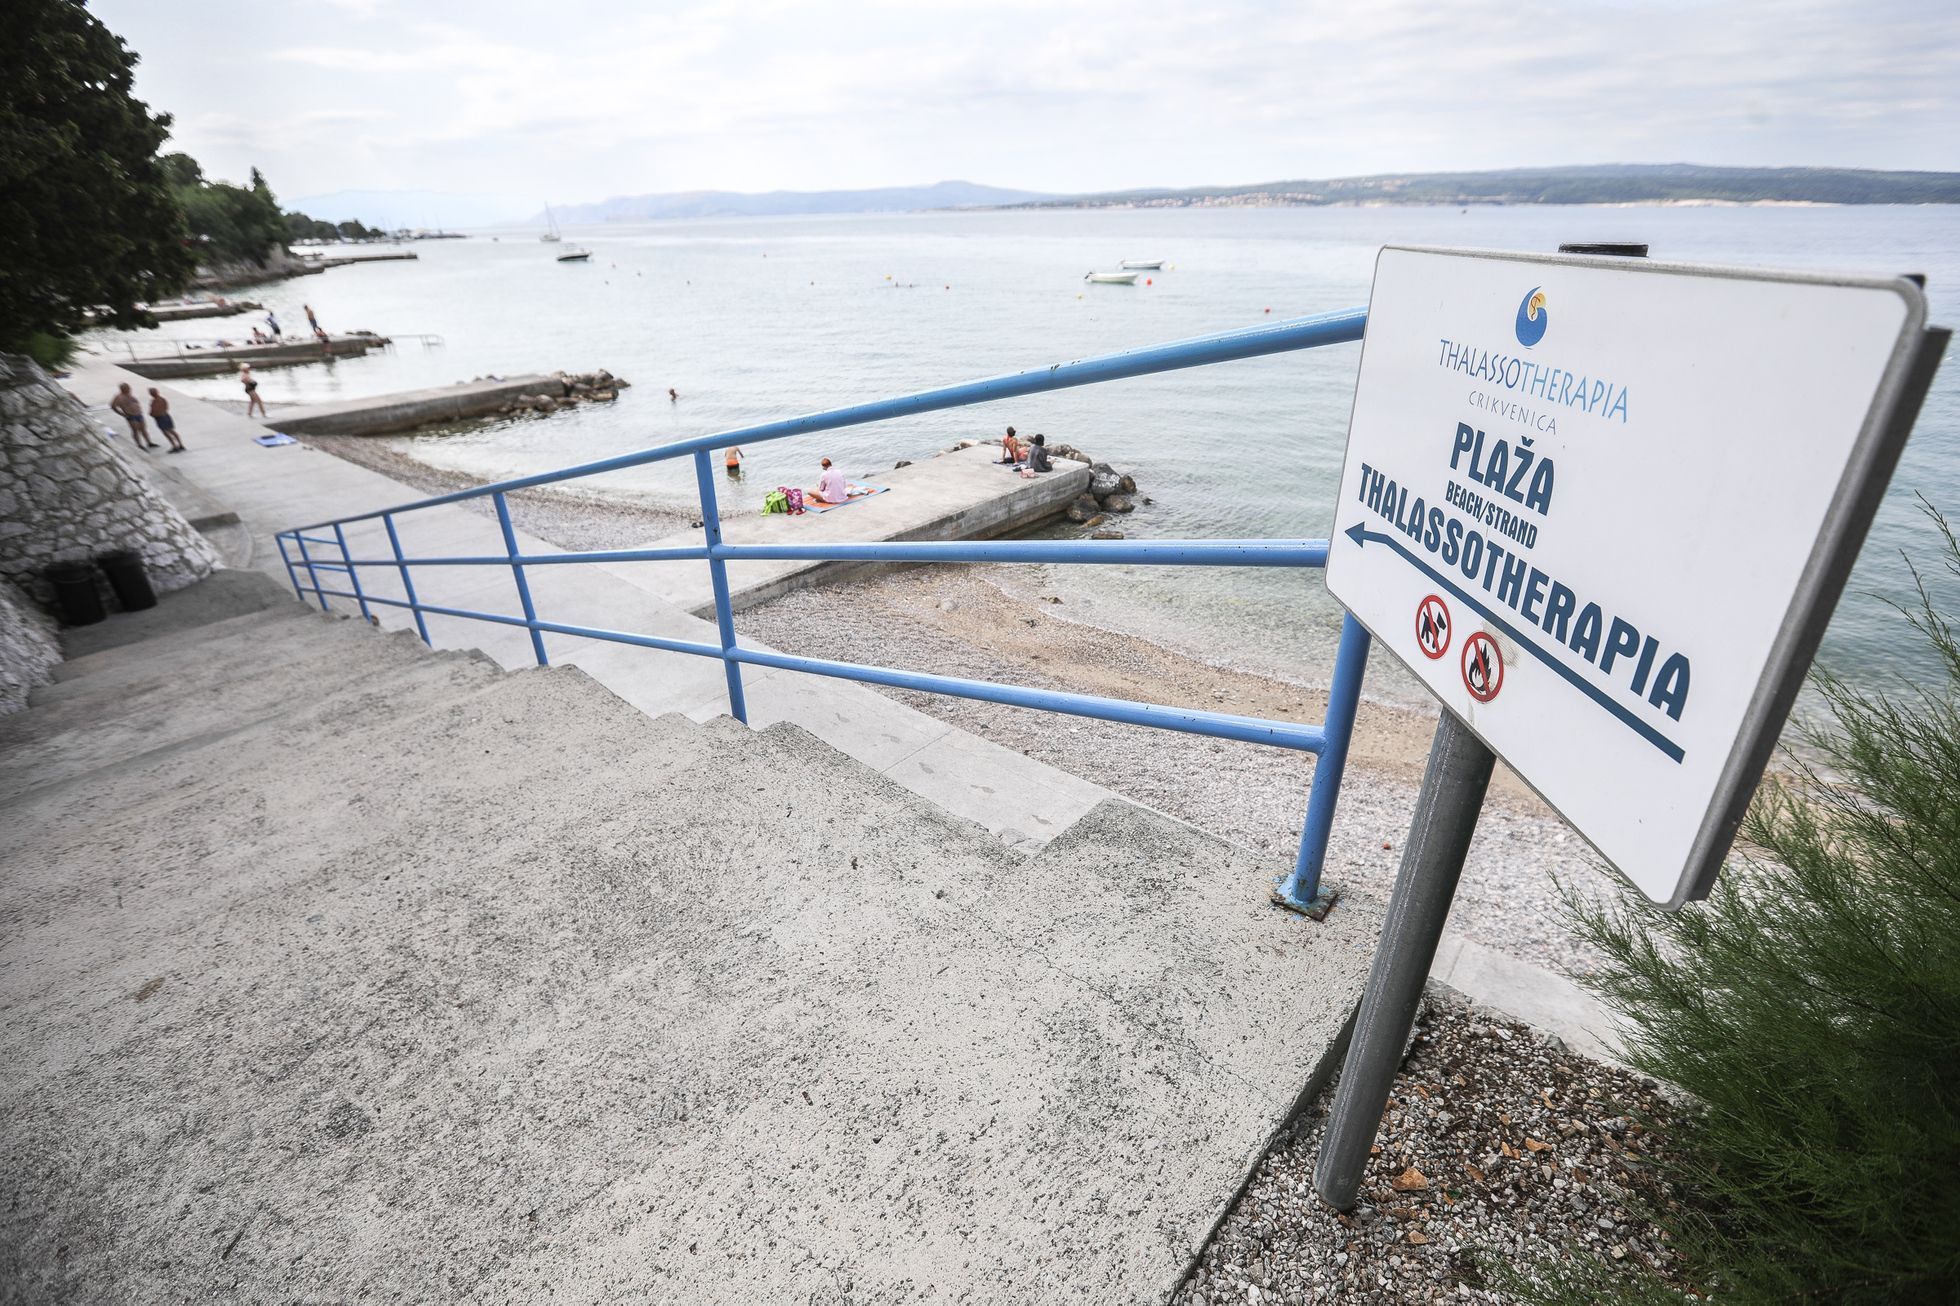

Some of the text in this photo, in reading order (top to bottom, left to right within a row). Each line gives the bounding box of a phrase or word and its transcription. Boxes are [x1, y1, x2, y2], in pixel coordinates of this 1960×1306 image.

[1439, 338, 1628, 424] THALASSOTHERAPIA
[1468, 390, 1557, 435] CRIKVENICA
[1449, 421, 1555, 516] PLAŽA
[1445, 480, 1538, 550] BEACH/STRAND
[1358, 462, 1691, 722] THALASSOTHERAPIA
